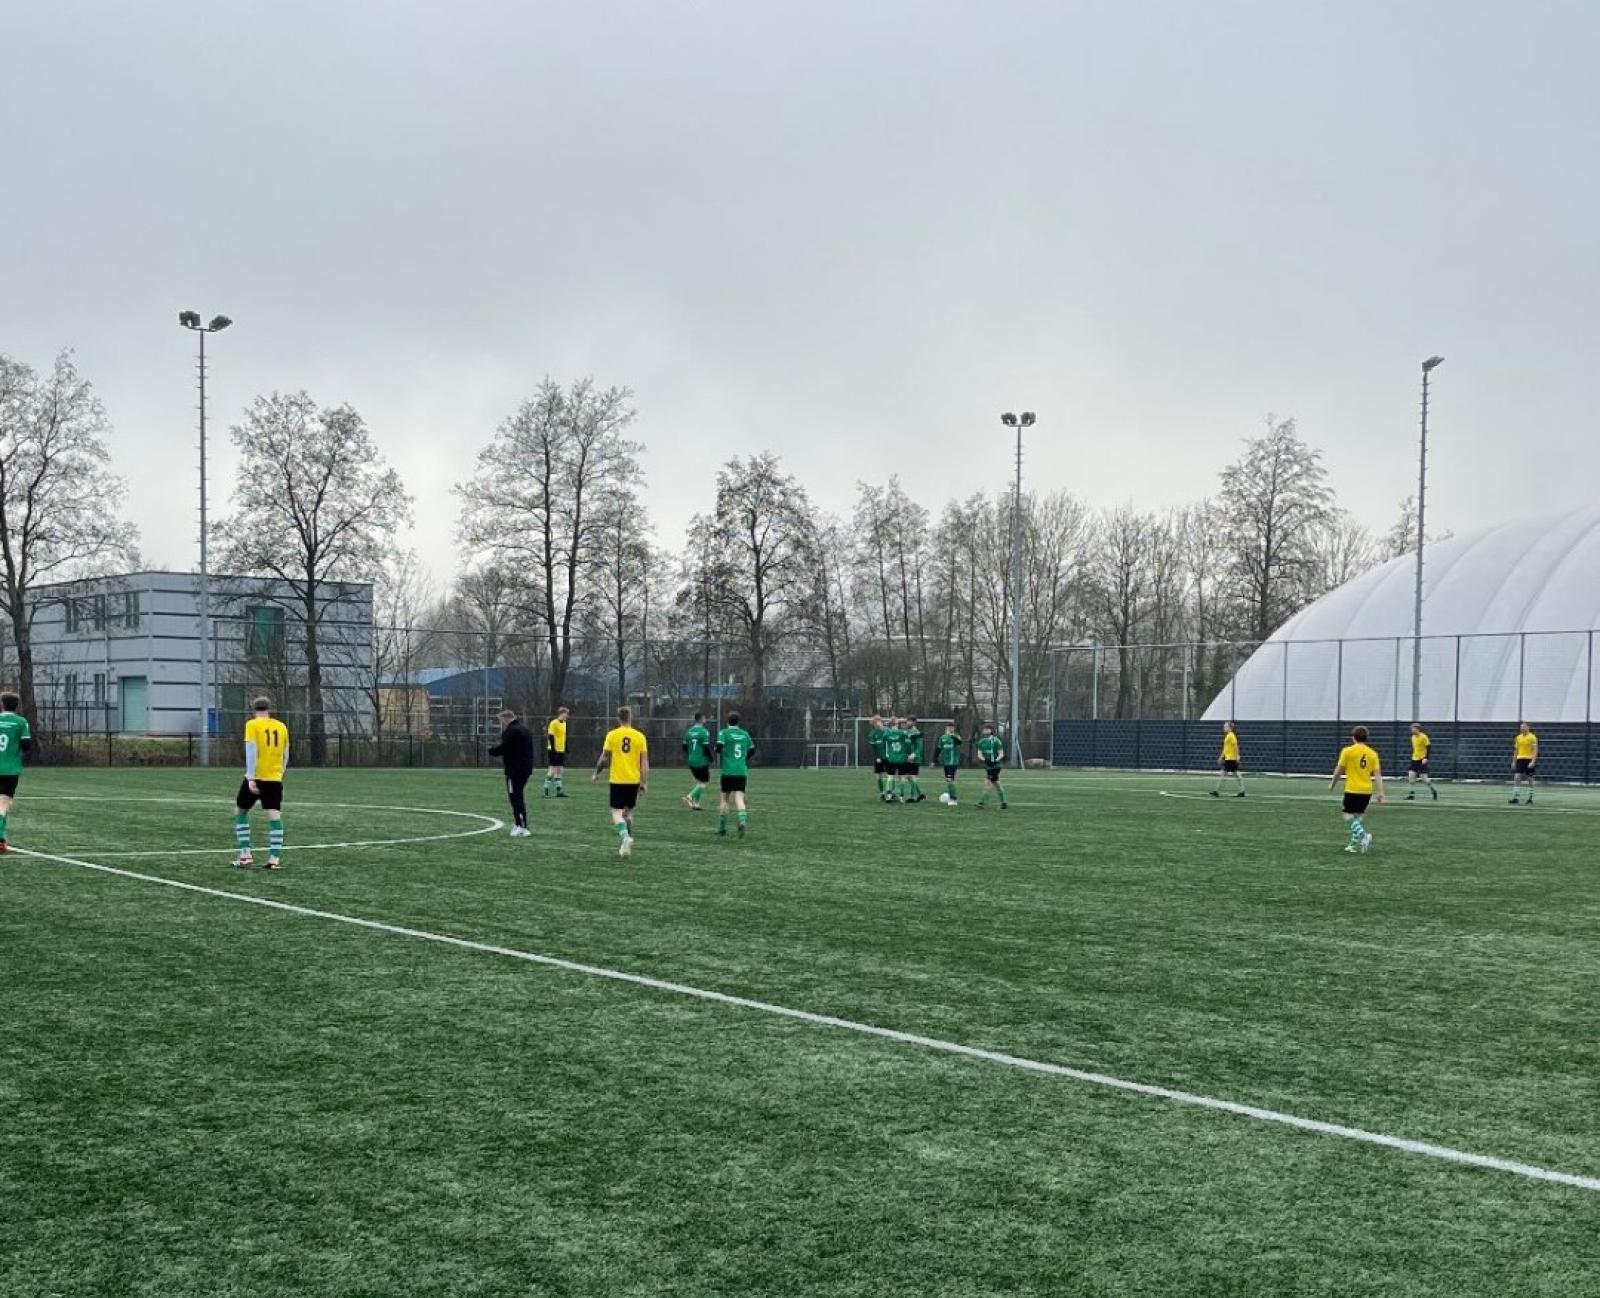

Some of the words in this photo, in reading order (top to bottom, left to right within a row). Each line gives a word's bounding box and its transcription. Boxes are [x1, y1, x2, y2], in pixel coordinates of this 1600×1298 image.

[0, 734, 9, 752] 9
[265, 728, 278, 747] 11
[622, 737, 631, 753] 8
[691, 739, 697, 751] 7
[734, 744, 742, 759] 5
[1360, 754, 1367, 769] 6
